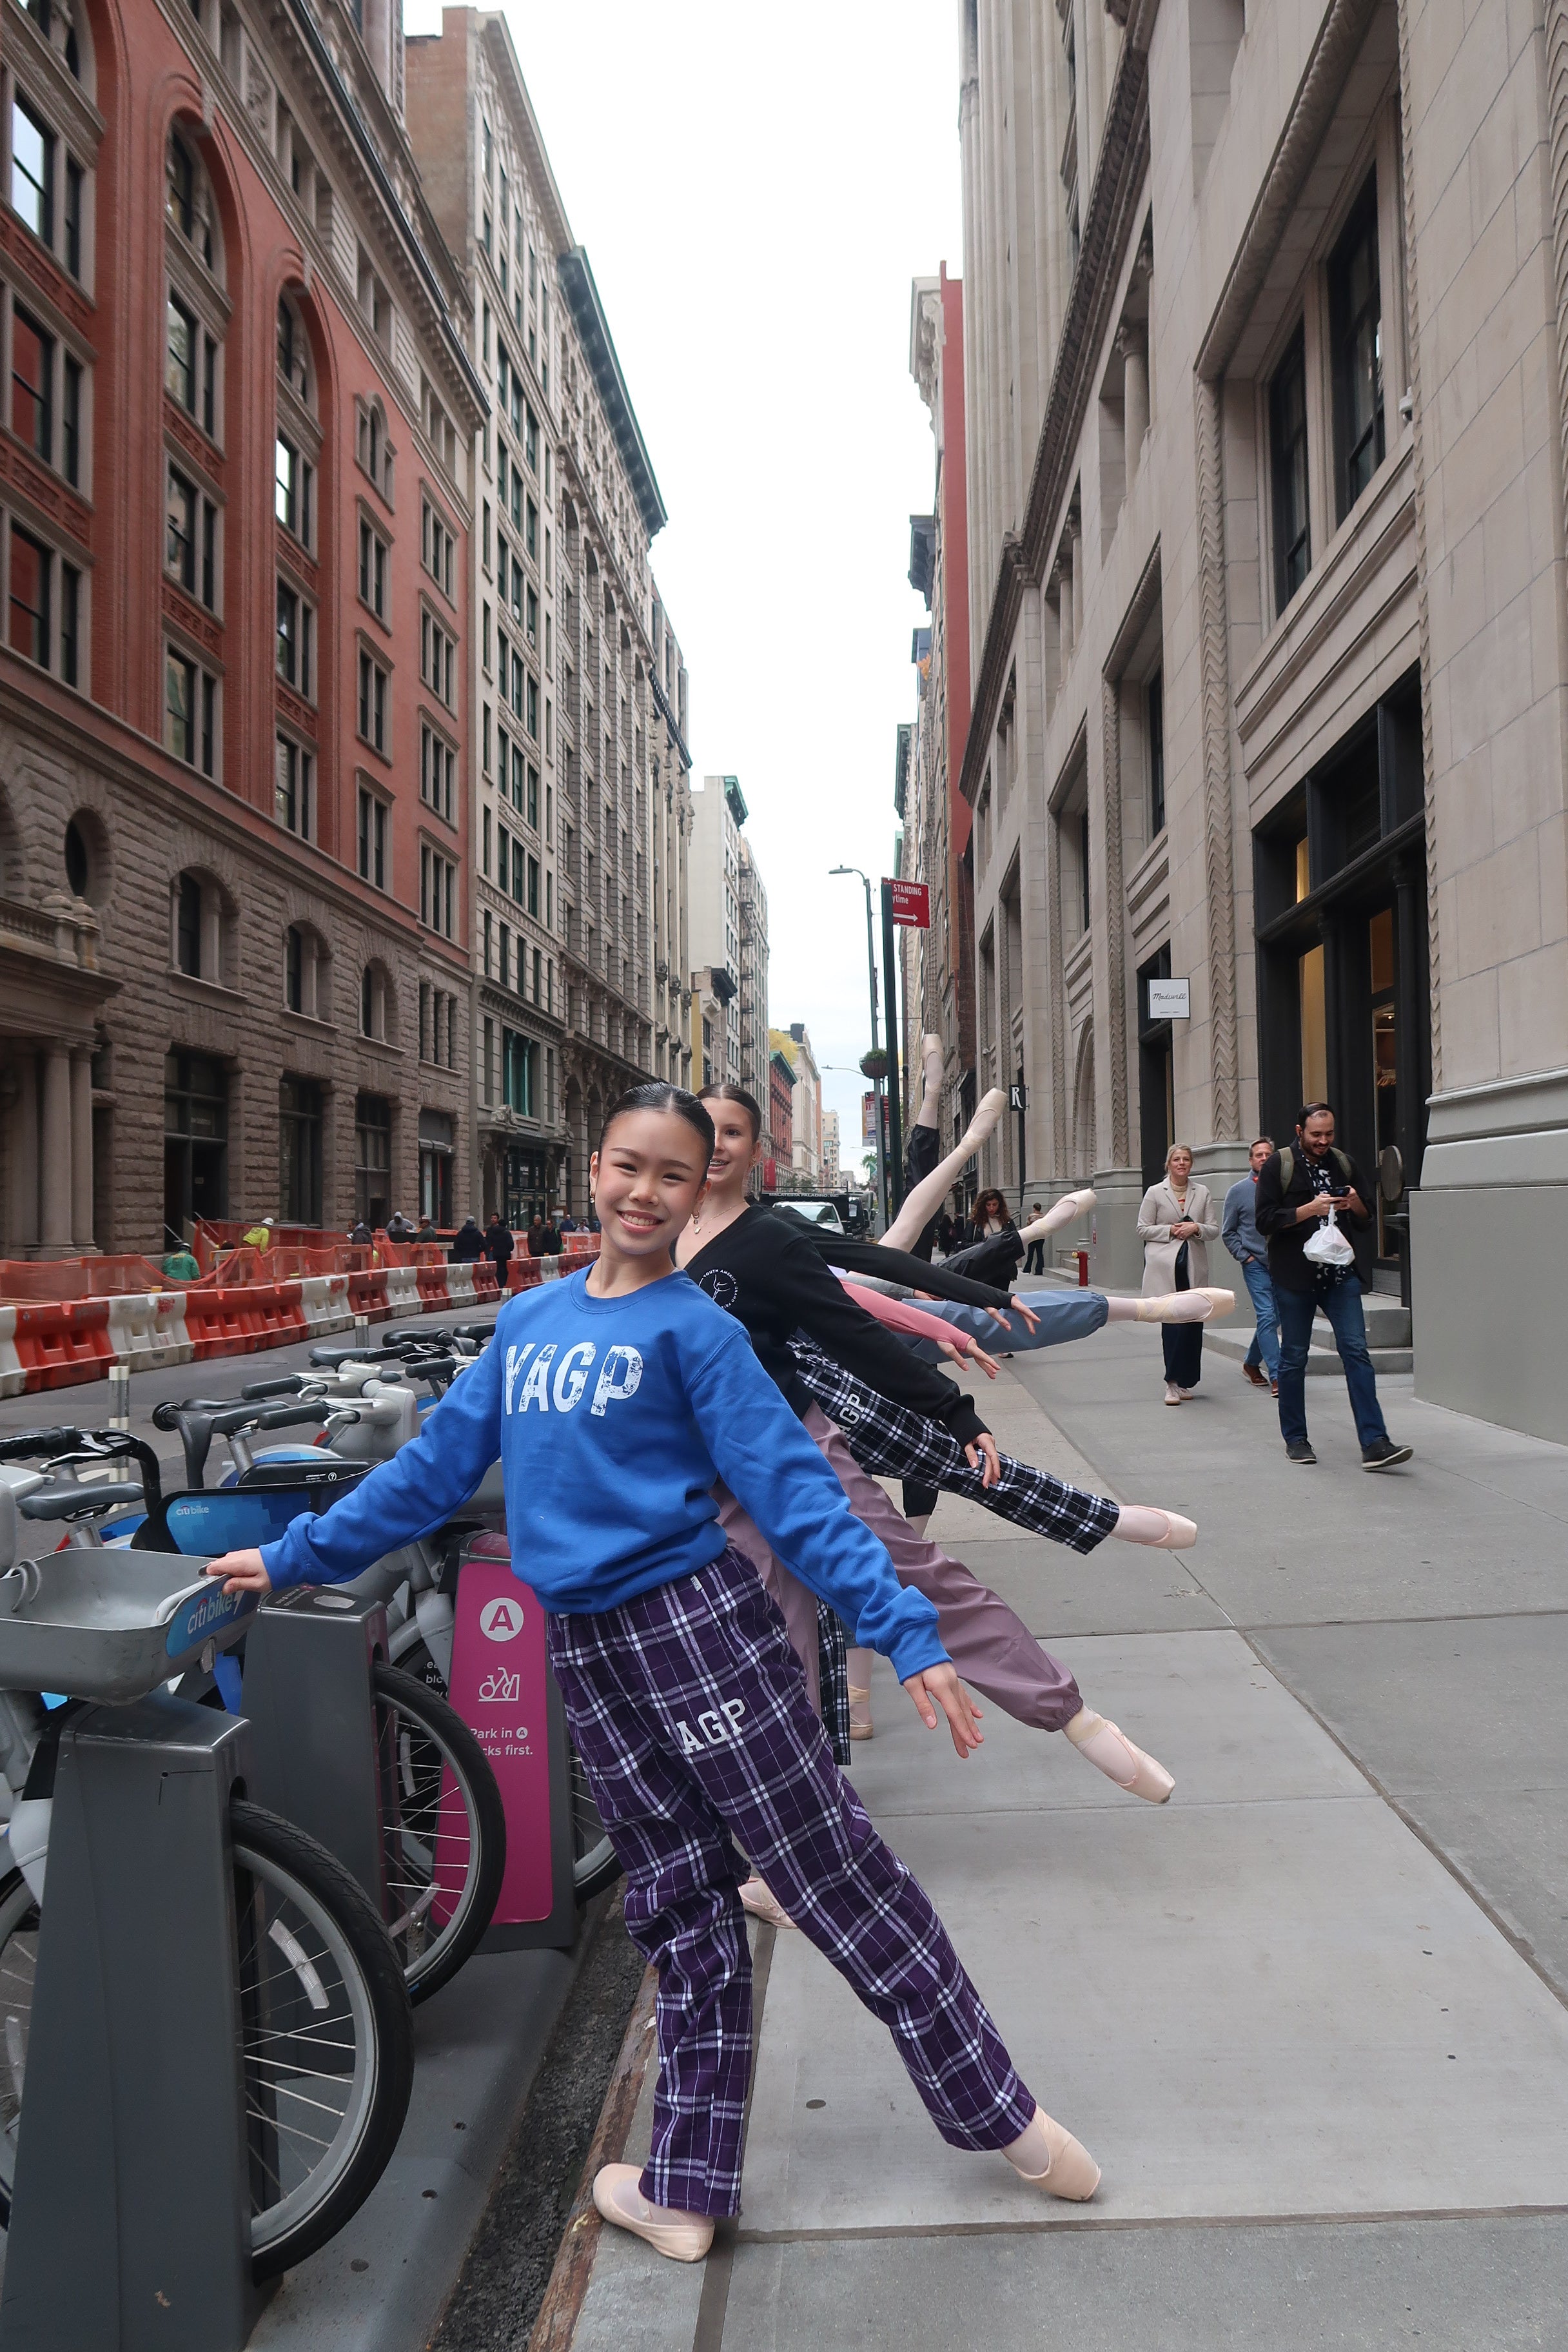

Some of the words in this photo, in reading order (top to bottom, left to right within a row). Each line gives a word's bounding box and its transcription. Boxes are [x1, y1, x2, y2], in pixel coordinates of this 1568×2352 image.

[894, 884, 922, 896] STANDING
[892, 894, 909, 904] ytime
[1012, 1087, 1023, 1109] R
[703, 1269, 719, 1278] YOUTH
[720, 1269, 737, 1284] AMERICA
[505, 1341, 643, 1417] YAGP
[836, 1393, 865, 1436] AGP
[488, 1605, 514, 1632] A
[501, 1727, 513, 1739] in
[505, 1744, 533, 1756] first.
